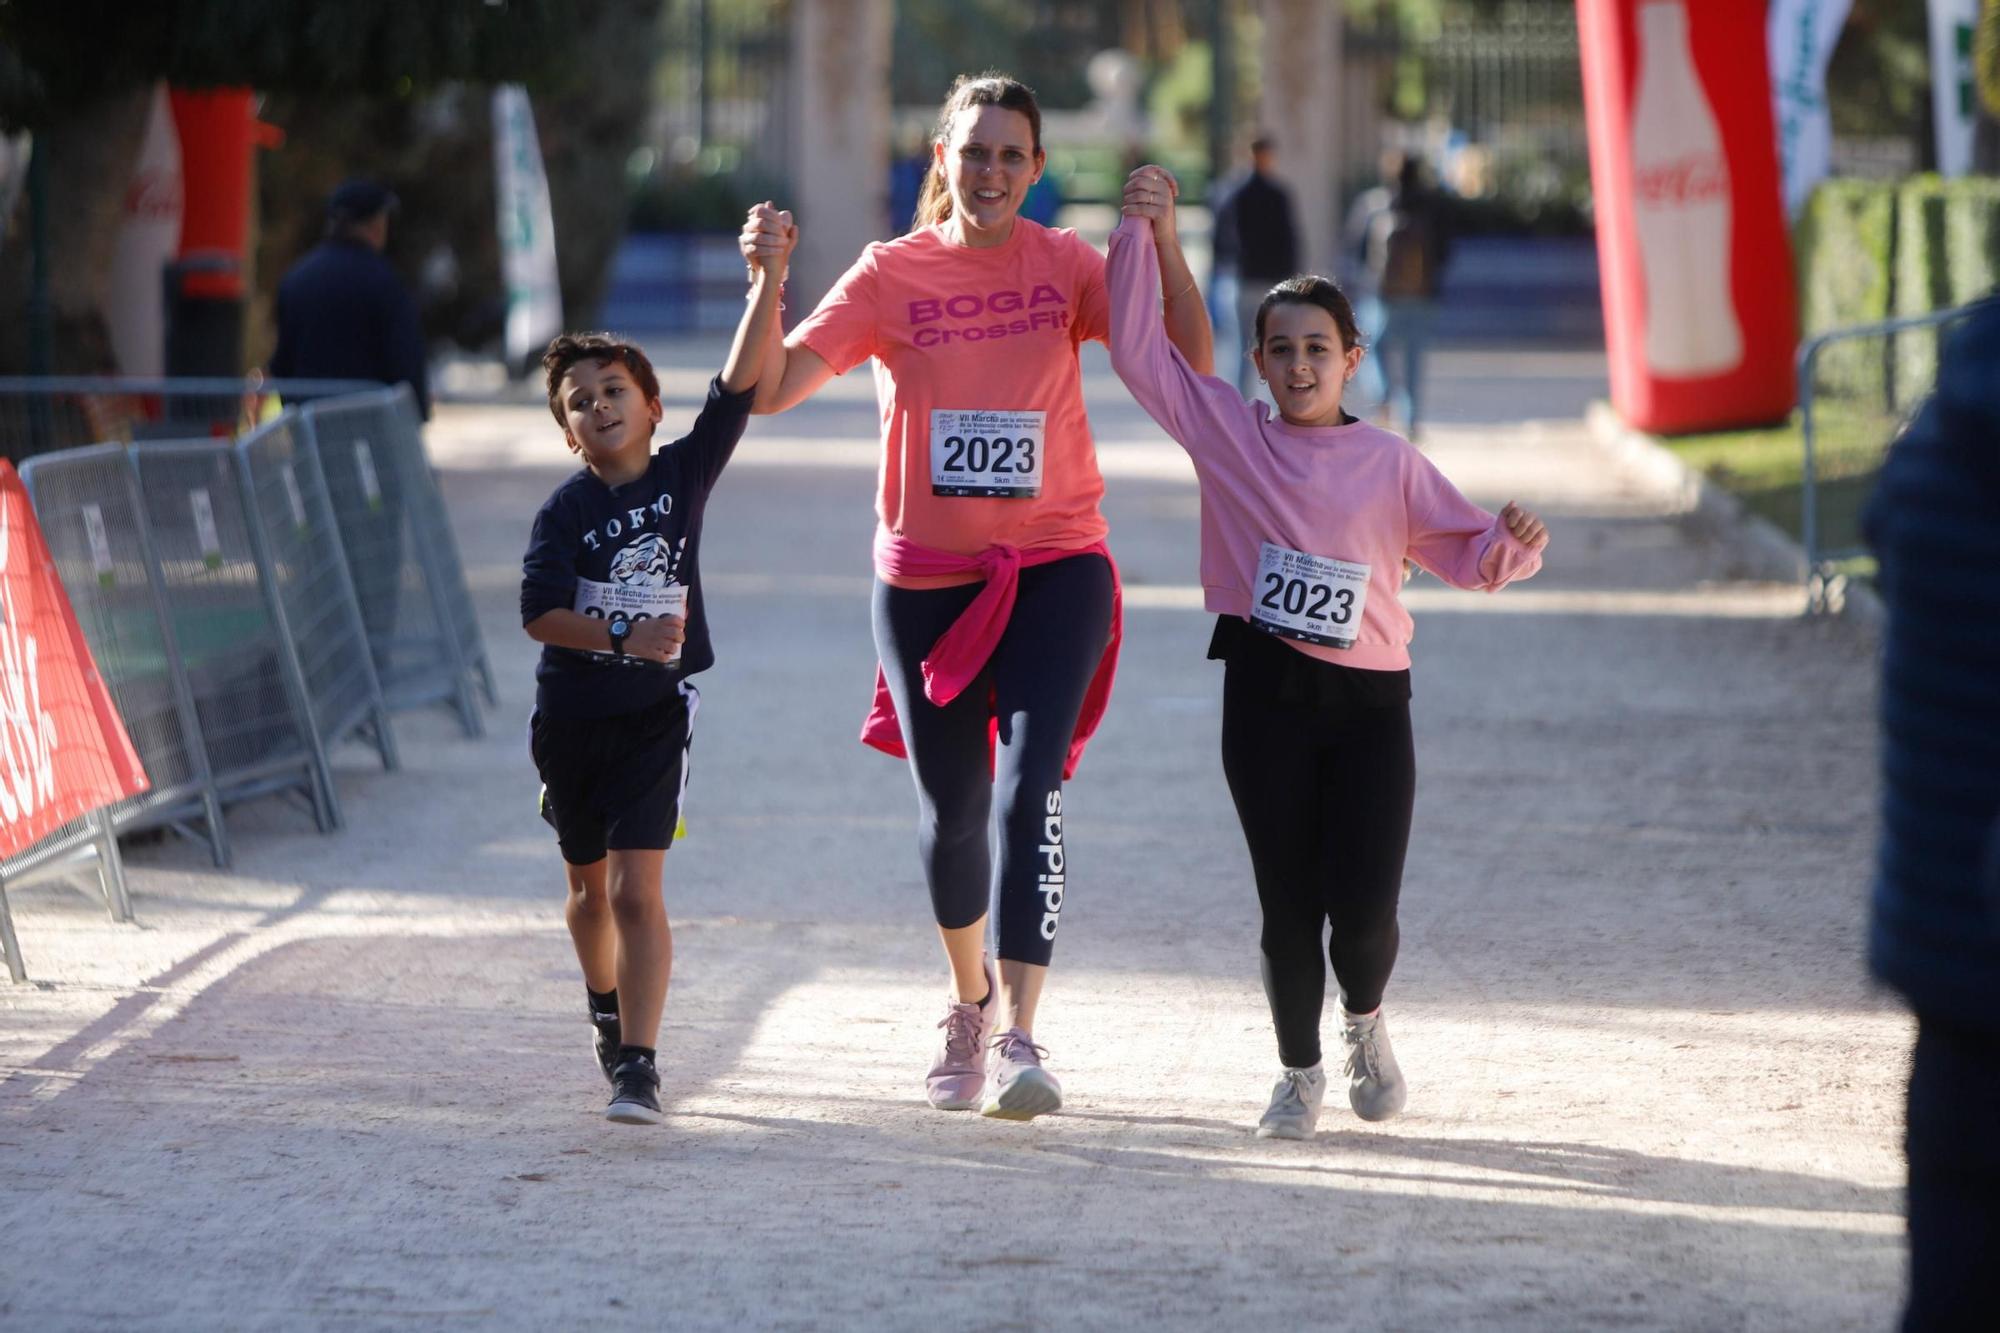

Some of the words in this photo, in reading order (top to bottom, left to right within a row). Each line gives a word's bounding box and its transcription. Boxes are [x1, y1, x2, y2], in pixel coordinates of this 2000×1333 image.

[909, 284, 1067, 325] BOGA
[913, 310, 1069, 347] CrossFit
[972, 414, 999, 423] Marcha
[943, 436, 1035, 473] 2023
[994, 476, 1010, 484] 5km
[1295, 555, 1324, 569] Marcha
[602, 586, 613, 595] VII
[615, 588, 642, 598] Marcha
[1261, 572, 1355, 625] 2023
[1306, 621, 1322, 631] 5km
[1038, 789, 1065, 941] adidas
